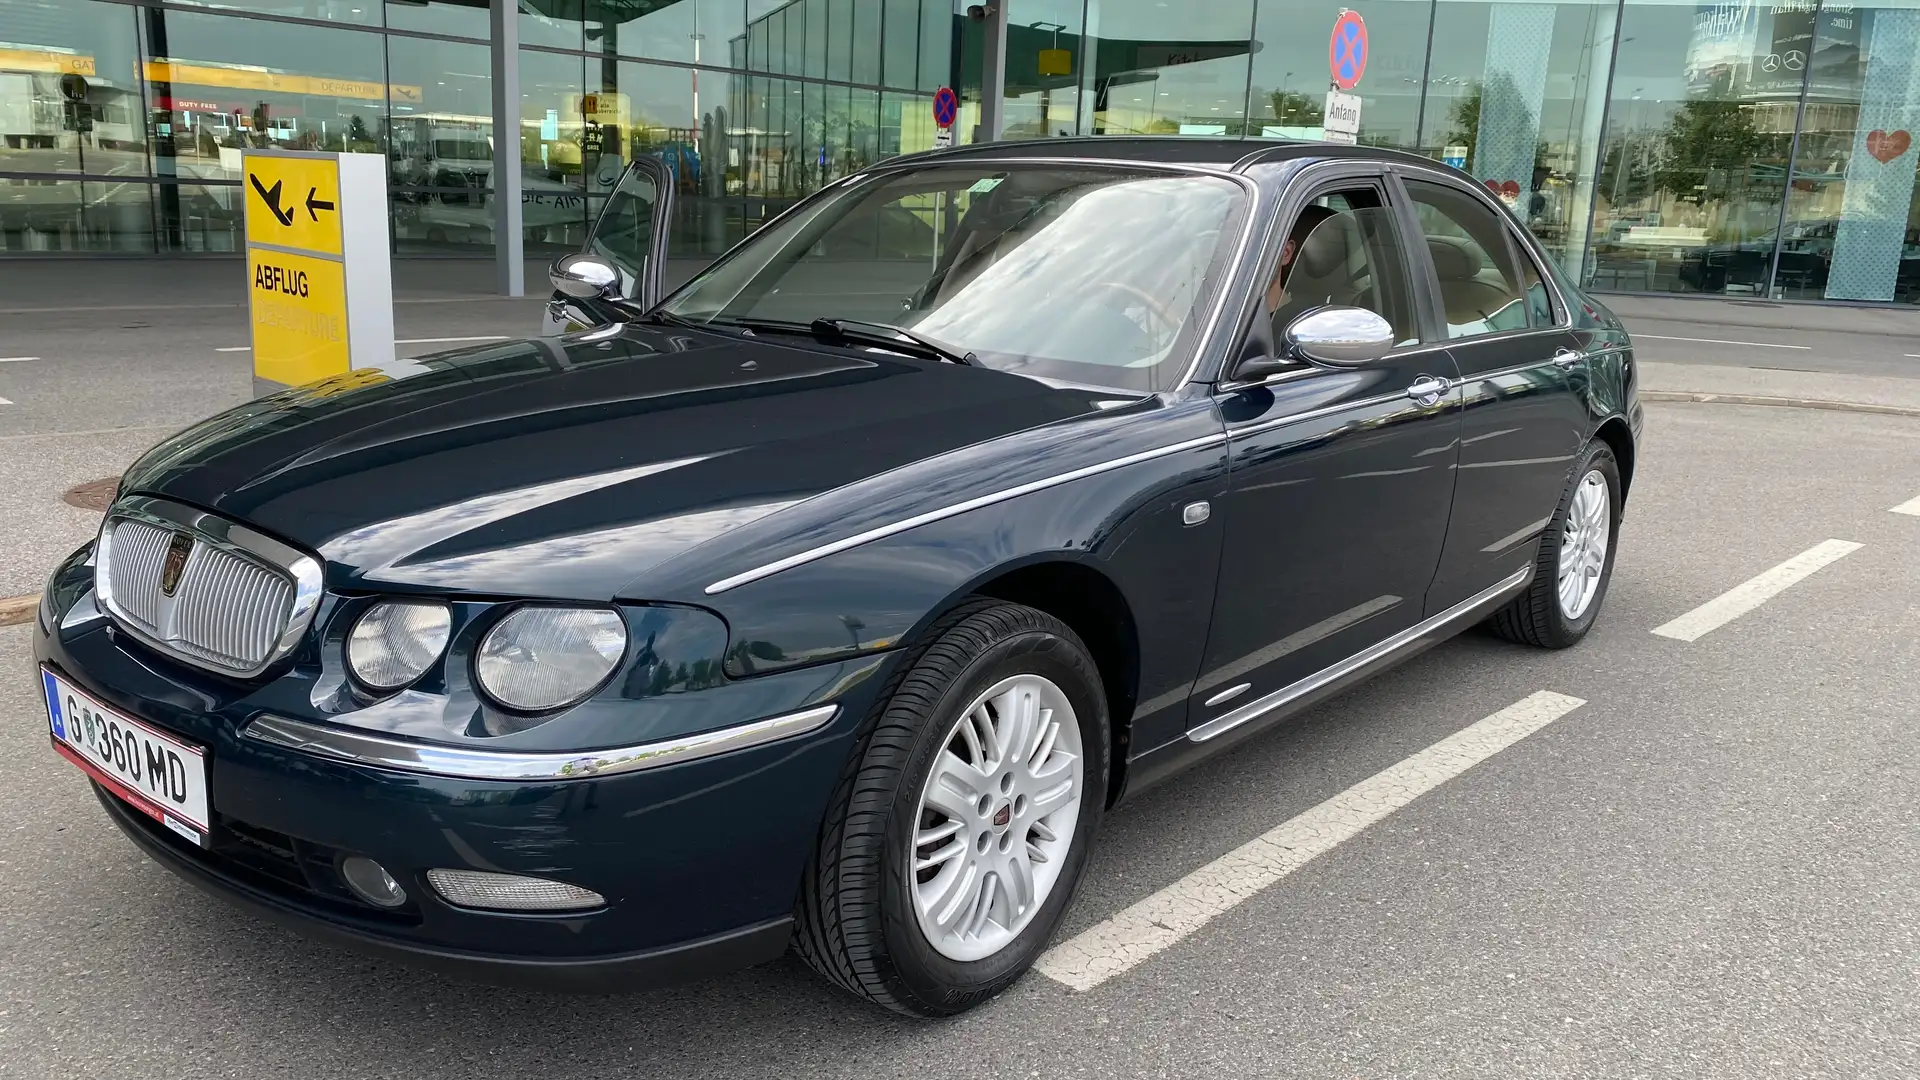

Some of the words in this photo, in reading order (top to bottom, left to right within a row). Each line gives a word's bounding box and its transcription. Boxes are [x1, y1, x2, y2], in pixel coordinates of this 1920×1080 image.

[1329, 102, 1357, 125] Anfang
[255, 263, 309, 298] ABFLUG
[256, 299, 341, 342] DEPARTURE
[173, 535, 192, 549] ROVER
[67, 694, 83, 743] G
[95, 713, 142, 782] 360
[145, 739, 187, 804] MD
